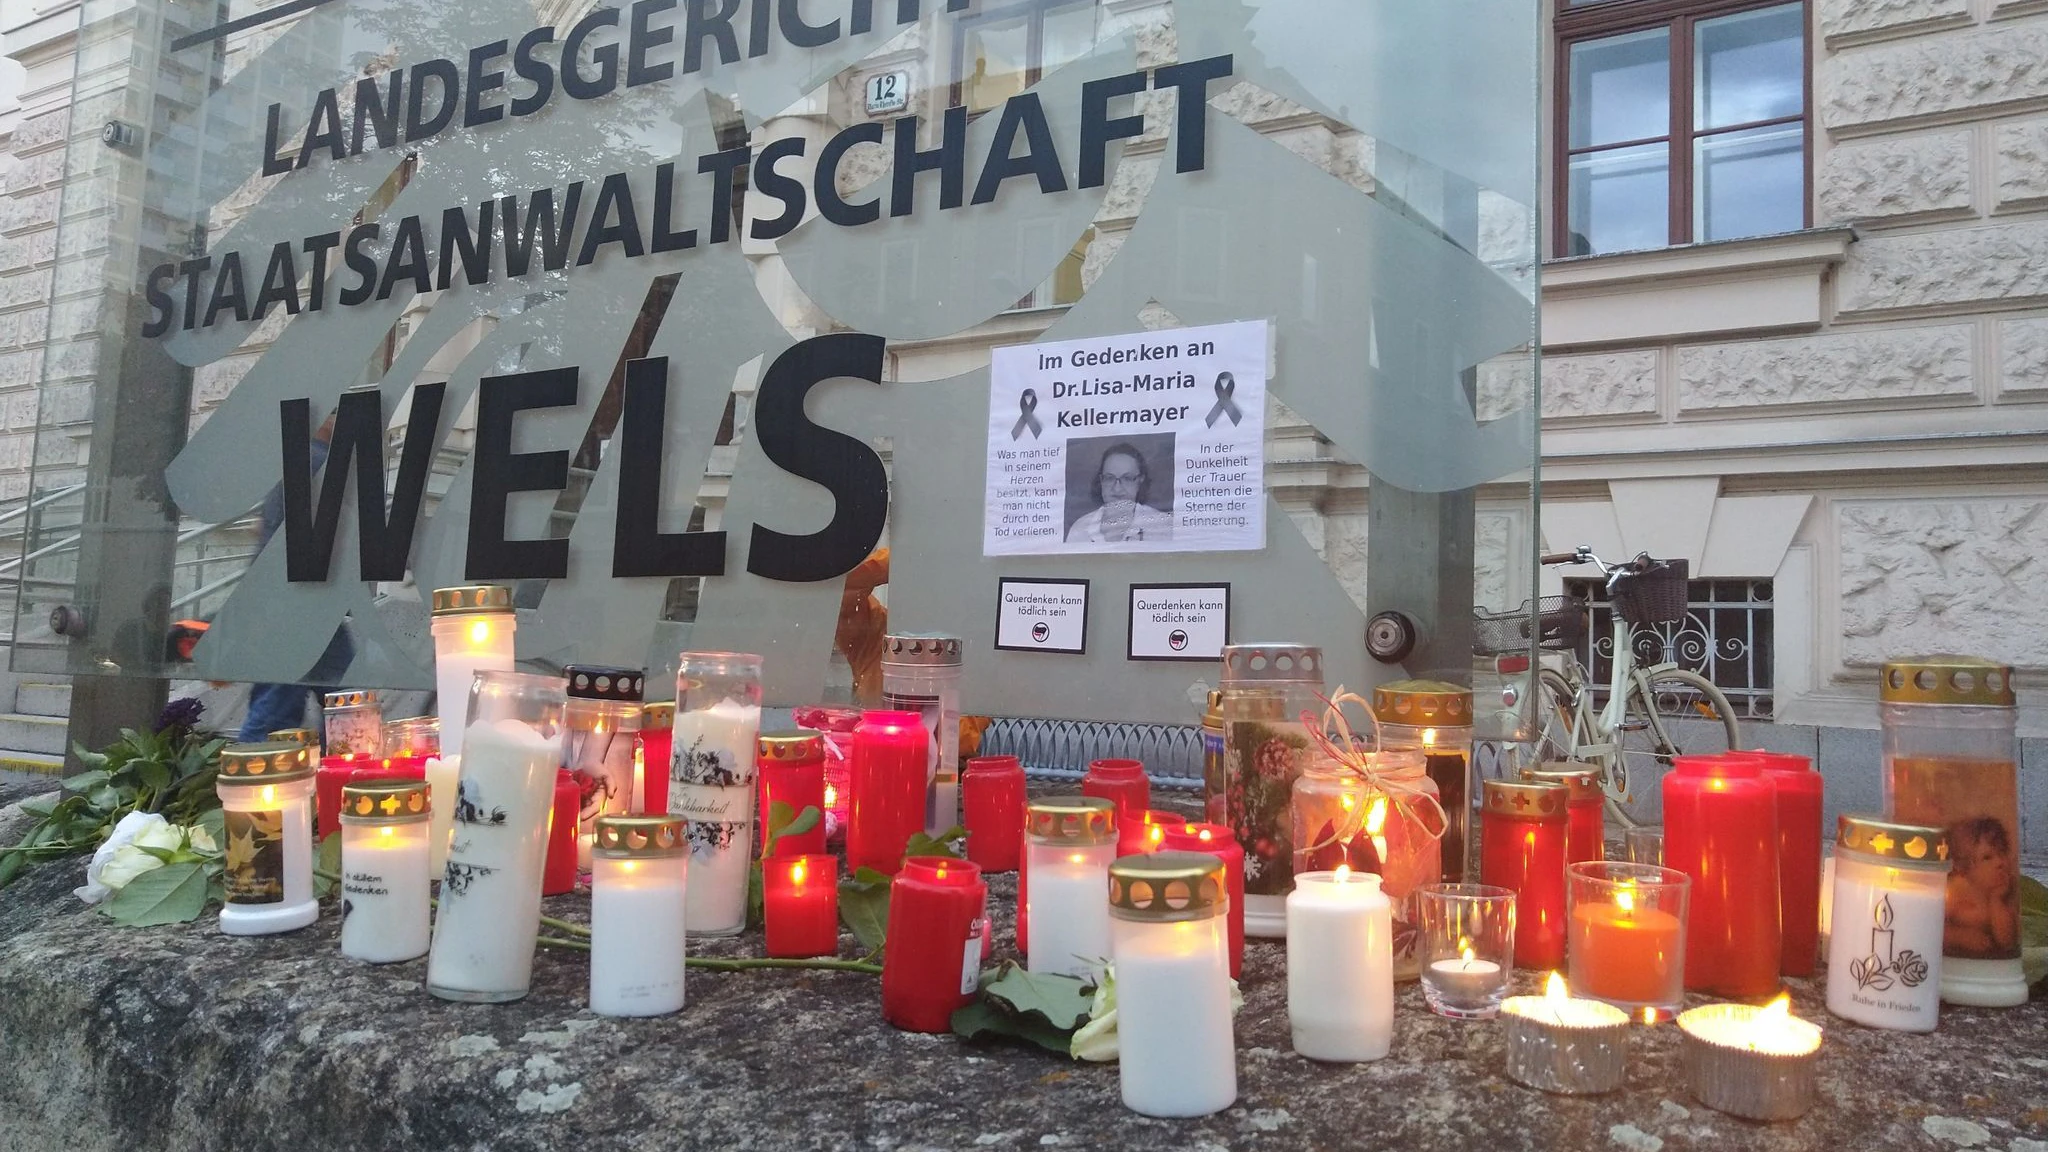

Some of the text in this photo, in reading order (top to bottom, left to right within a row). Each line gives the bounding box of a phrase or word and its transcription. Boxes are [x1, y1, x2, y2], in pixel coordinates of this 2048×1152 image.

[262, 0, 969, 177] LANDESGERIC
[875, 75, 896, 101] 12
[142, 53, 1233, 338] STAATSANWALTSCHAFT
[1038, 341, 1215, 371] Im Gedenken an
[1052, 371, 1196, 399] Dr.Lisa-Maria
[1057, 405, 1190, 428] Kellermayer
[997, 446, 1061, 460] Was man tief
[1200, 442, 1234, 454] In der
[280, 332, 888, 583] WELS
[1185, 456, 1249, 470] Dunkelheit
[1004, 460, 1052, 472] in seinem
[1010, 475, 1044, 485] Herzen
[1186, 472, 1247, 484] der Trauer
[1034, 487, 1059, 497] kann
[1181, 484, 1252, 498] leuchten die
[1002, 500, 1051, 511] man nicht
[1185, 500, 1246, 513] Sterne der
[1002, 513, 1050, 524] durch den
[1182, 516, 1249, 528] Erinnerung.
[994, 526, 1059, 537] Tod verlieren.
[1004, 592, 1083, 605] Querdenken kann
[1136, 599, 1224, 611] Querdenken kann
[1017, 605, 1067, 617] tödlich sein
[1151, 611, 1207, 623] tödlich sein
[1851, 993, 1921, 1013] Ruhe in Frieden
